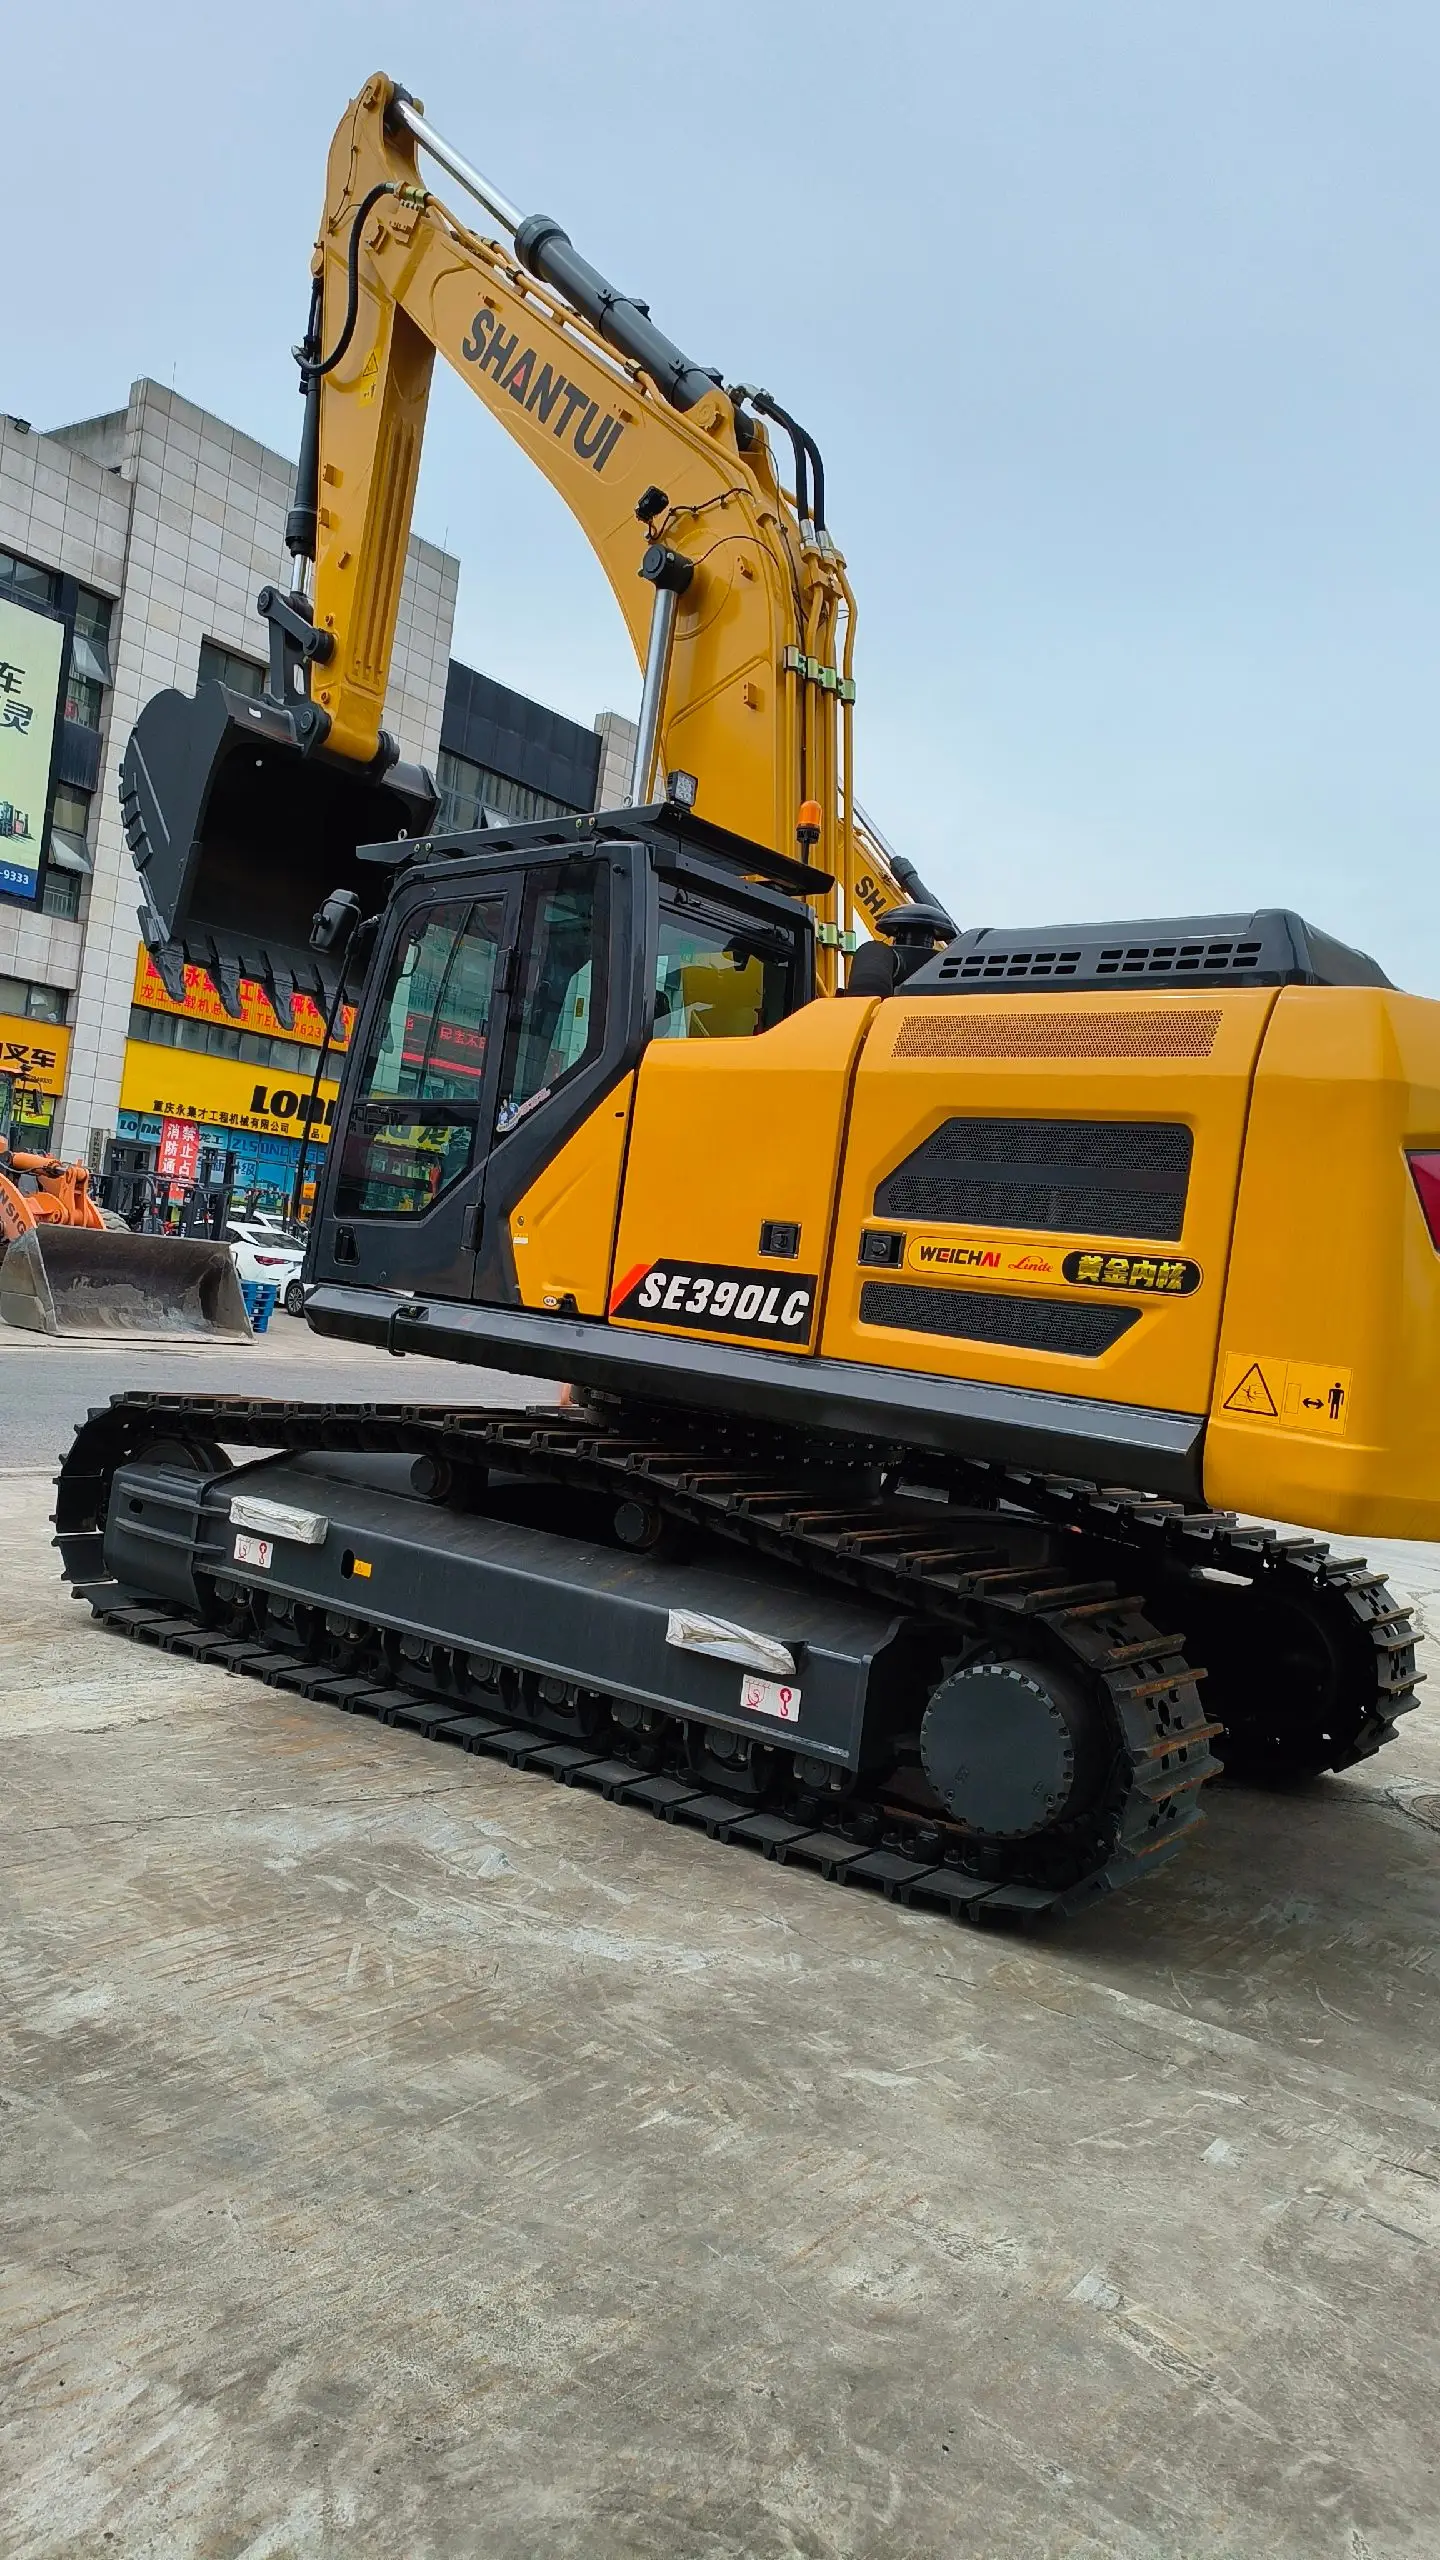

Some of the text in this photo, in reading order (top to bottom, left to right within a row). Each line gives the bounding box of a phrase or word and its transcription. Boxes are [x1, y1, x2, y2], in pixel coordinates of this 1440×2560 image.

[463, 309, 625, 473] SHANTUI
[0, 1042, 57, 1068] 叉车
[153, 1099, 290, 1134] 重庆永集才工程机械有限公司
[162, 1123, 181, 1176] 消防通
[178, 1126, 196, 1190] 禁止占
[919, 1245, 1055, 1273] WEICHAI Linde
[1076, 1255, 1187, 1290] 黄金内核
[638, 1272, 811, 1326] SE390LC
